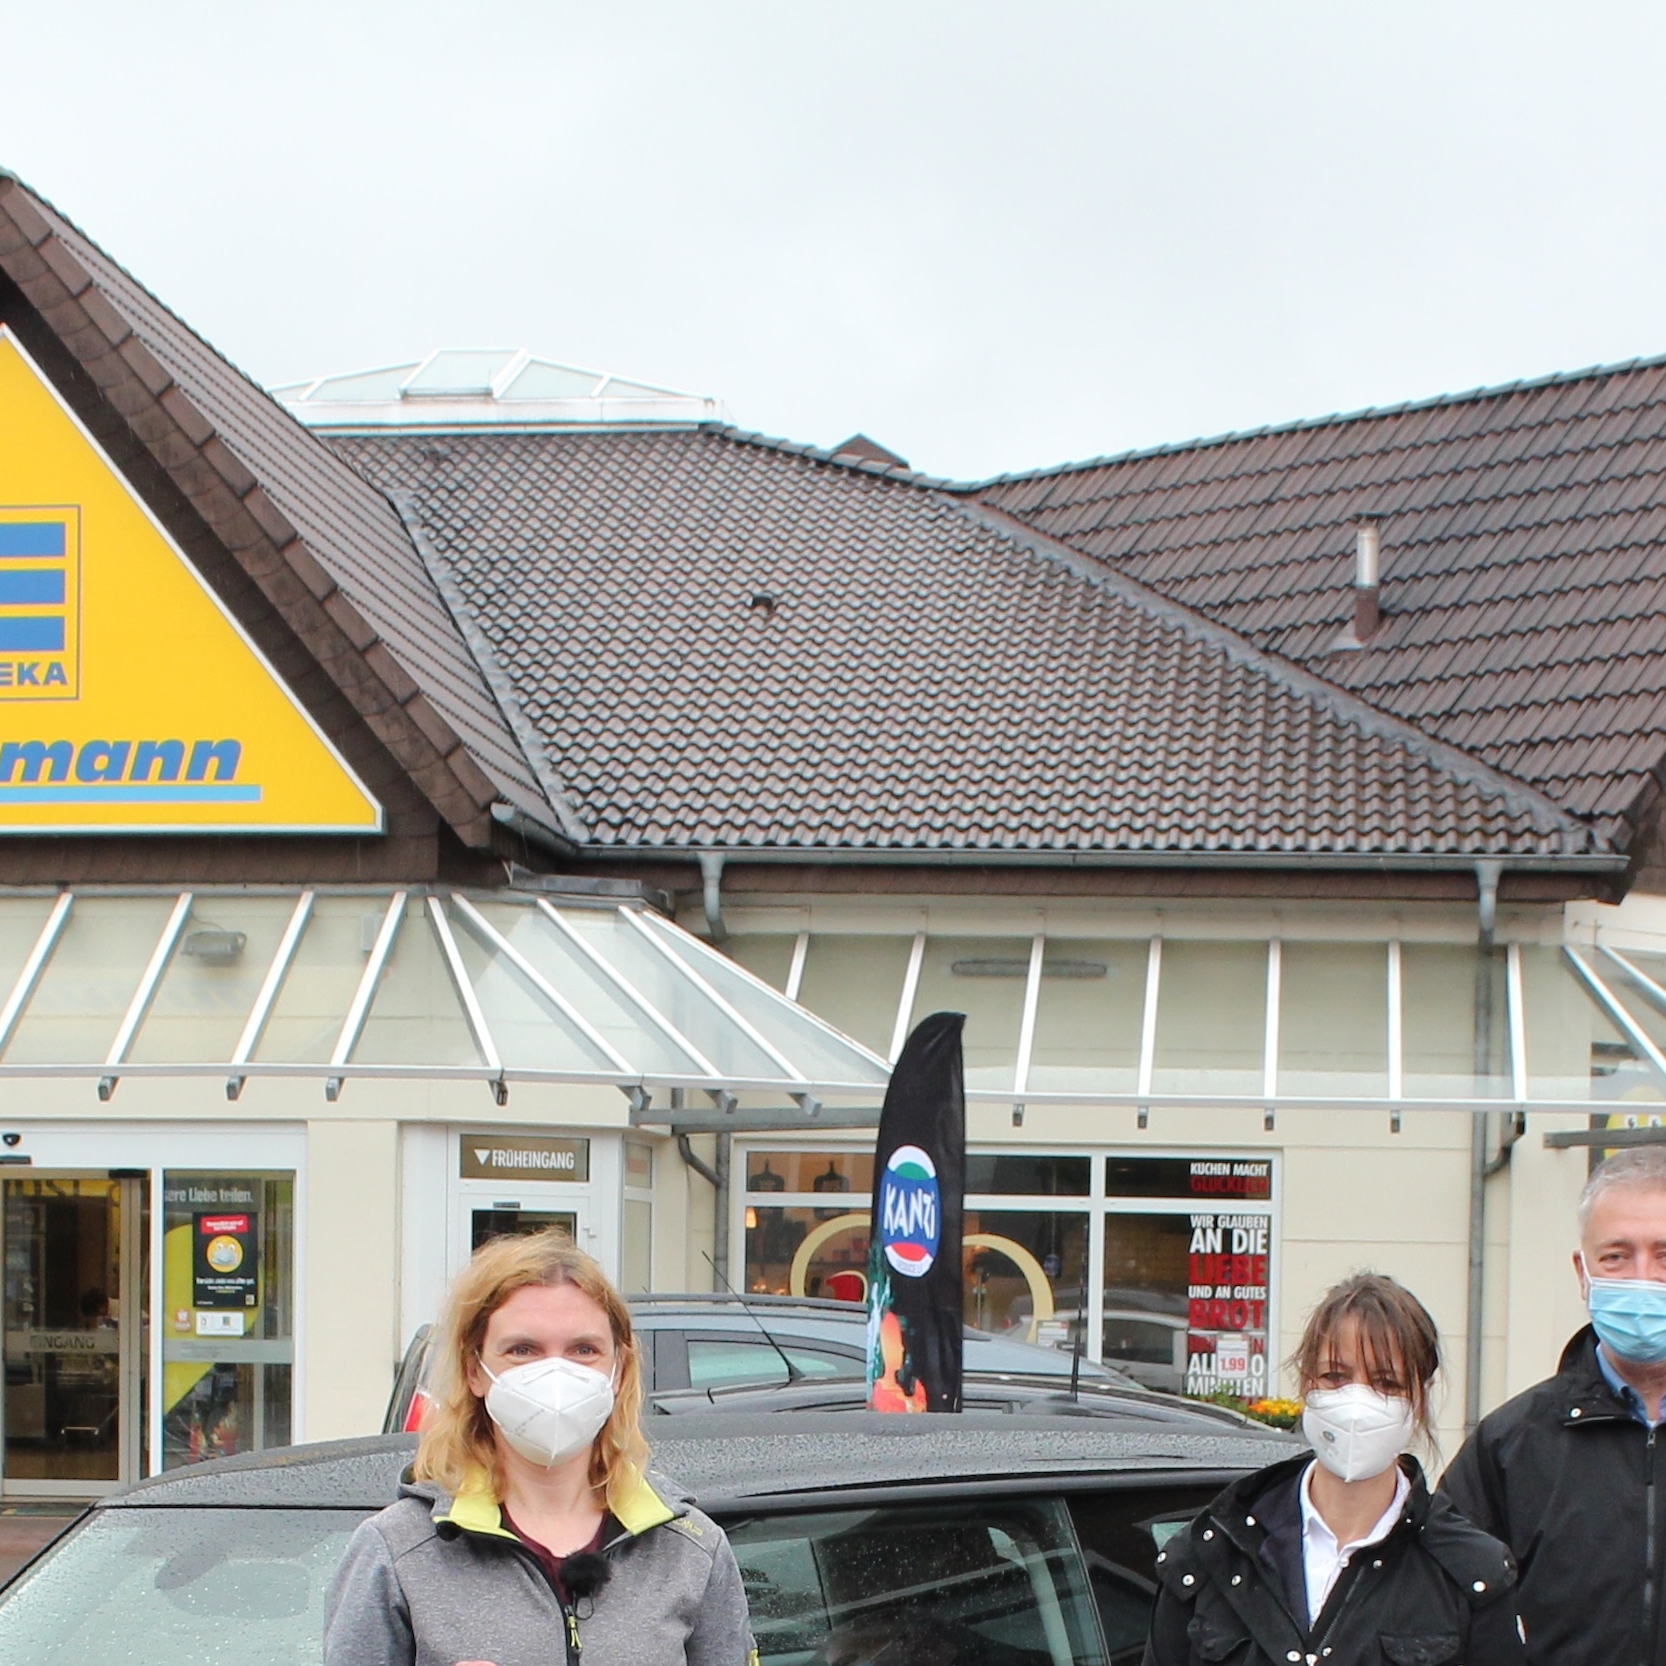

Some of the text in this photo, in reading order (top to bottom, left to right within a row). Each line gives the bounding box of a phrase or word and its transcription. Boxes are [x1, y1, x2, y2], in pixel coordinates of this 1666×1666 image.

[492, 1149, 574, 1169] FRÜHEINGANG
[1190, 1162, 1268, 1177] KUCHEN MACHT
[1190, 1215, 1268, 1229] WIR GLAUBEN
[1189, 1228, 1267, 1254] AN DIE
[1189, 1254, 1268, 1285] LIEBE
[1188, 1285, 1267, 1299] UND AN GUTES
[1188, 1299, 1265, 1329] BROT
